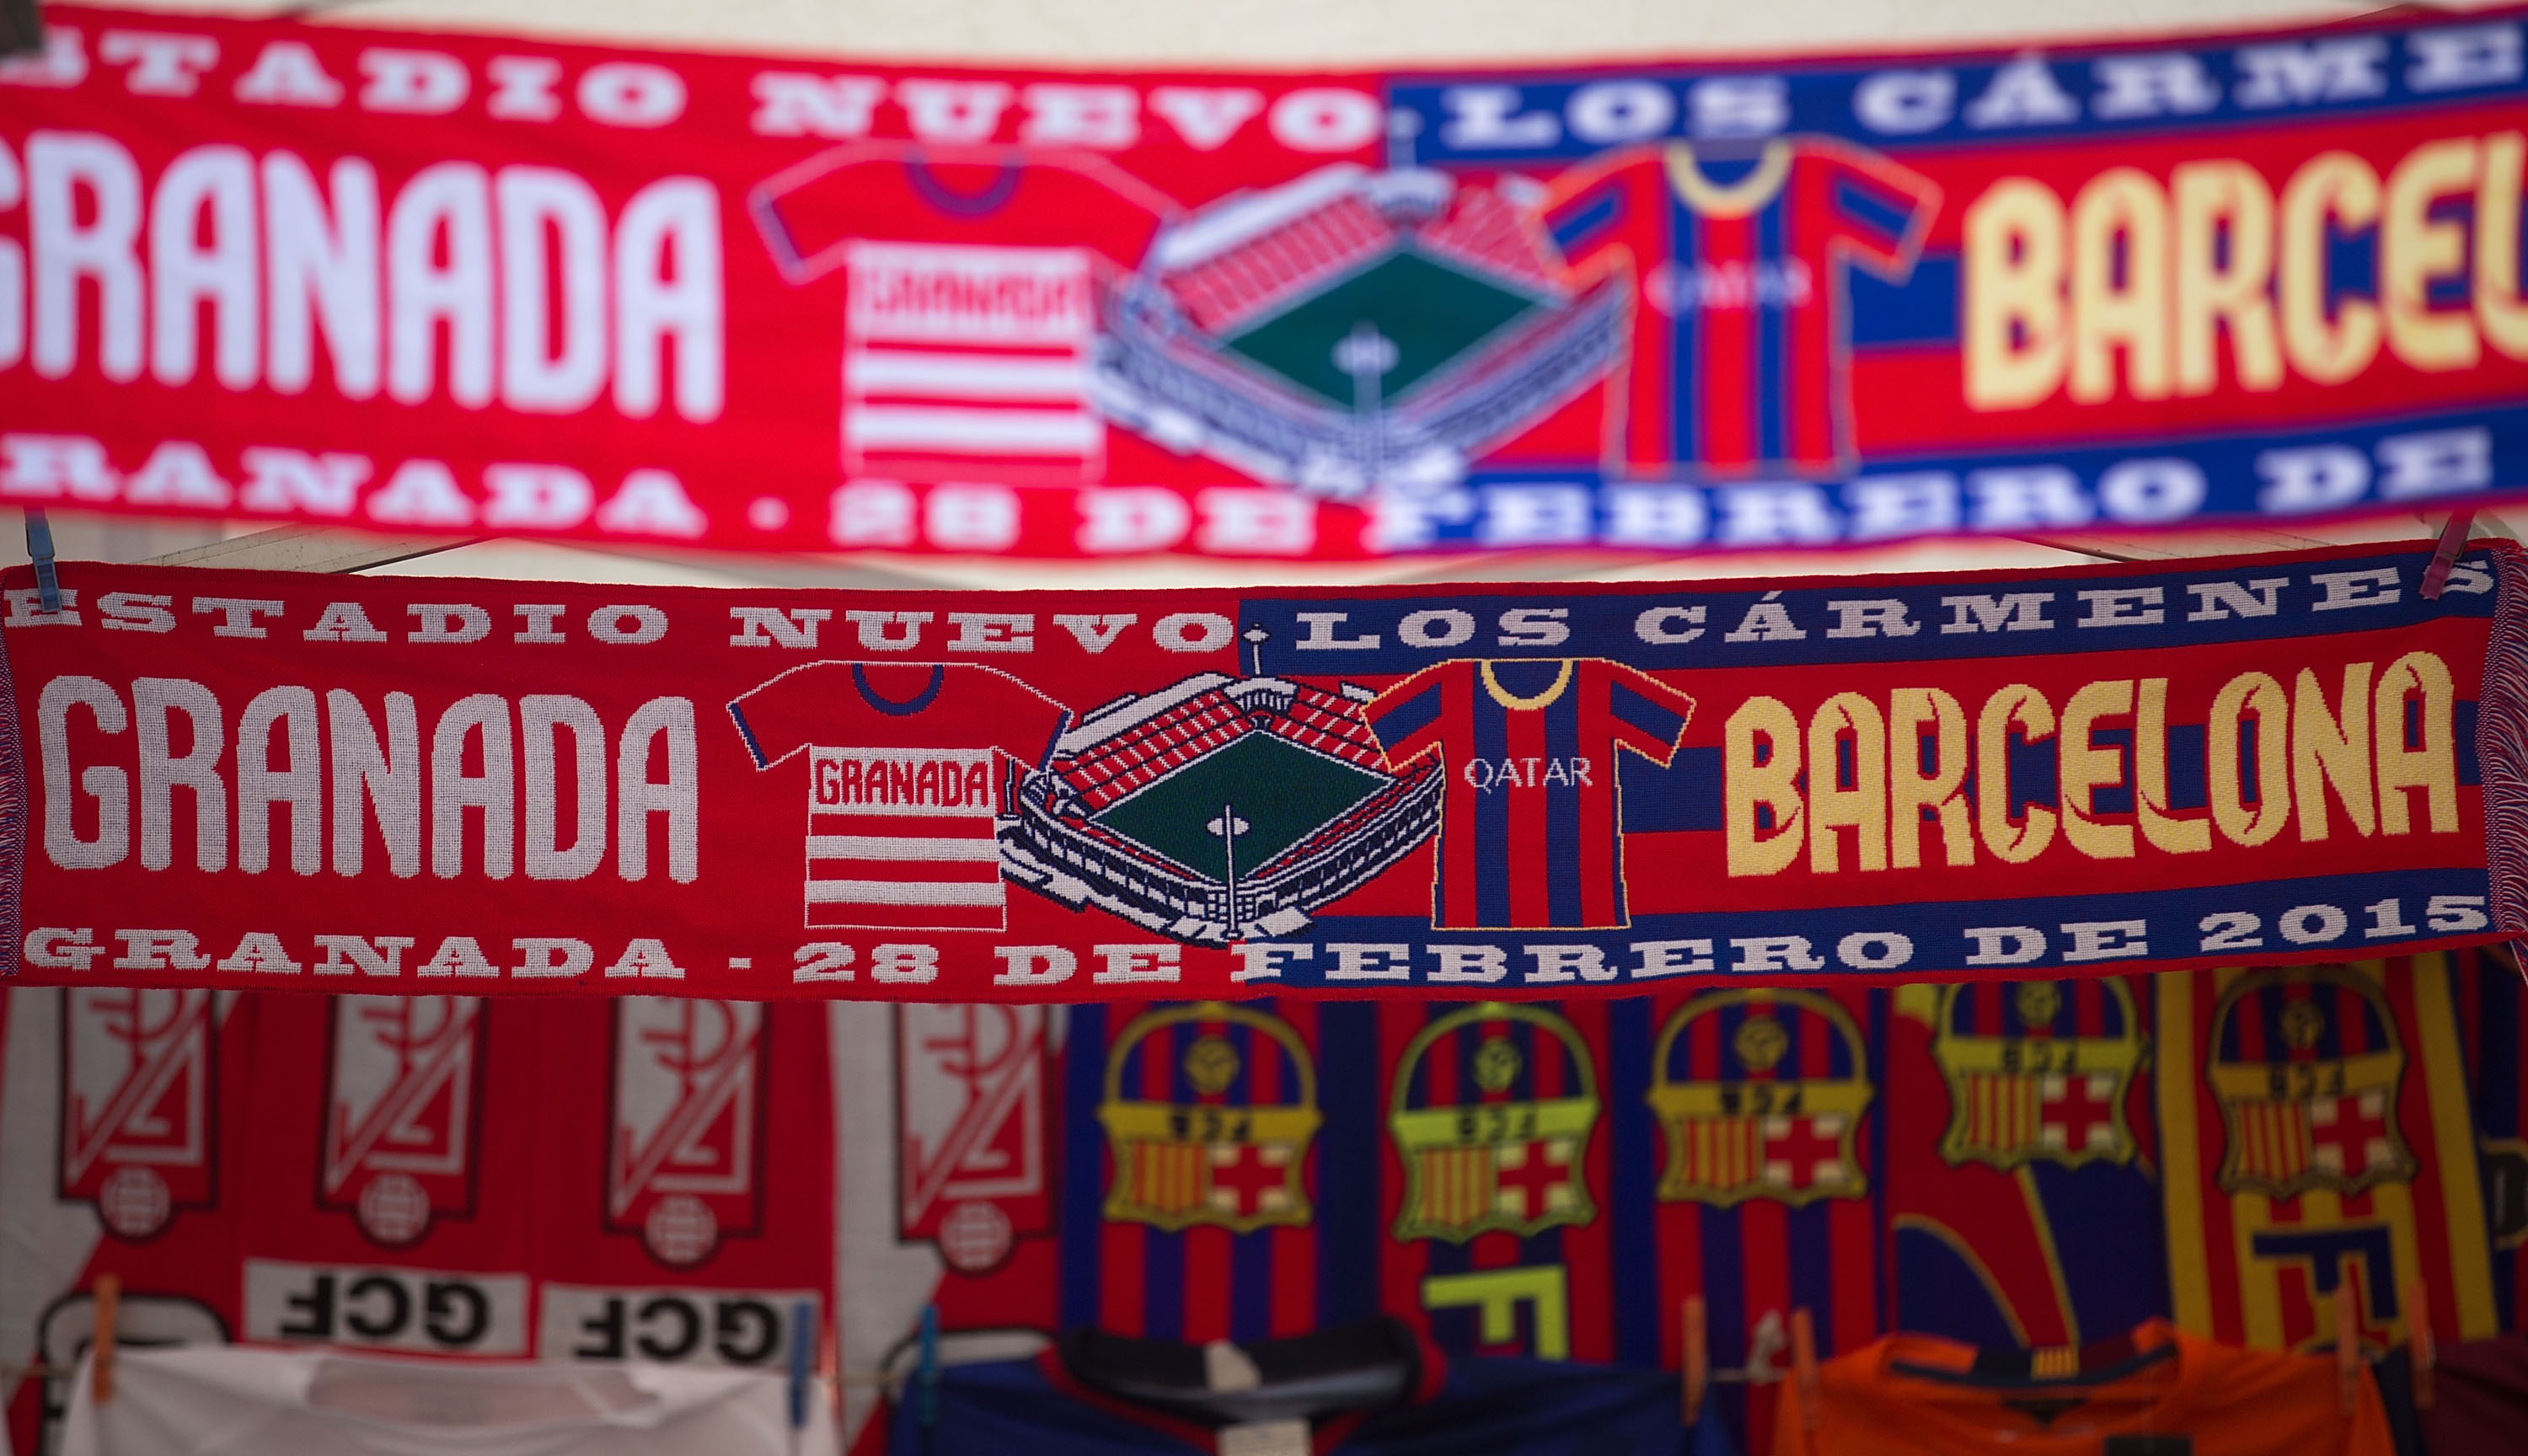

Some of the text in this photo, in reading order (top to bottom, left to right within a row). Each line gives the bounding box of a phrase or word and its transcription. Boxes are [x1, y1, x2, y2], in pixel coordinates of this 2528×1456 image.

[750, 72, 1379, 150] NUEVO
[1443, 76, 1788, 147] LOS
[0, 129, 725, 423] RANADA
[1077, 484, 1315, 552] DE
[1363, 458, 2205, 553] FEBRERO
[2258, 428, 2490, 514] DE
[4, 559, 2494, 654] ESTADIO NUEVO LOS CÁRMENES
[38, 676, 698, 884] GRANADA
[816, 760, 988, 806] GRANADA
[1464, 757, 1593, 795] QATAR
[1725, 651, 2459, 877] BARCELONA
[24, 927, 685, 980] GRANADA
[793, 942, 939, 984] 28
[994, 944, 1181, 986] DE
[1230, 930, 1914, 983] FEBRERO
[1964, 919, 2149, 966] DE
[2199, 895, 2489, 953] 2015
[280, 1272, 490, 1348] GCF
[576, 1295, 782, 1366] GCF
